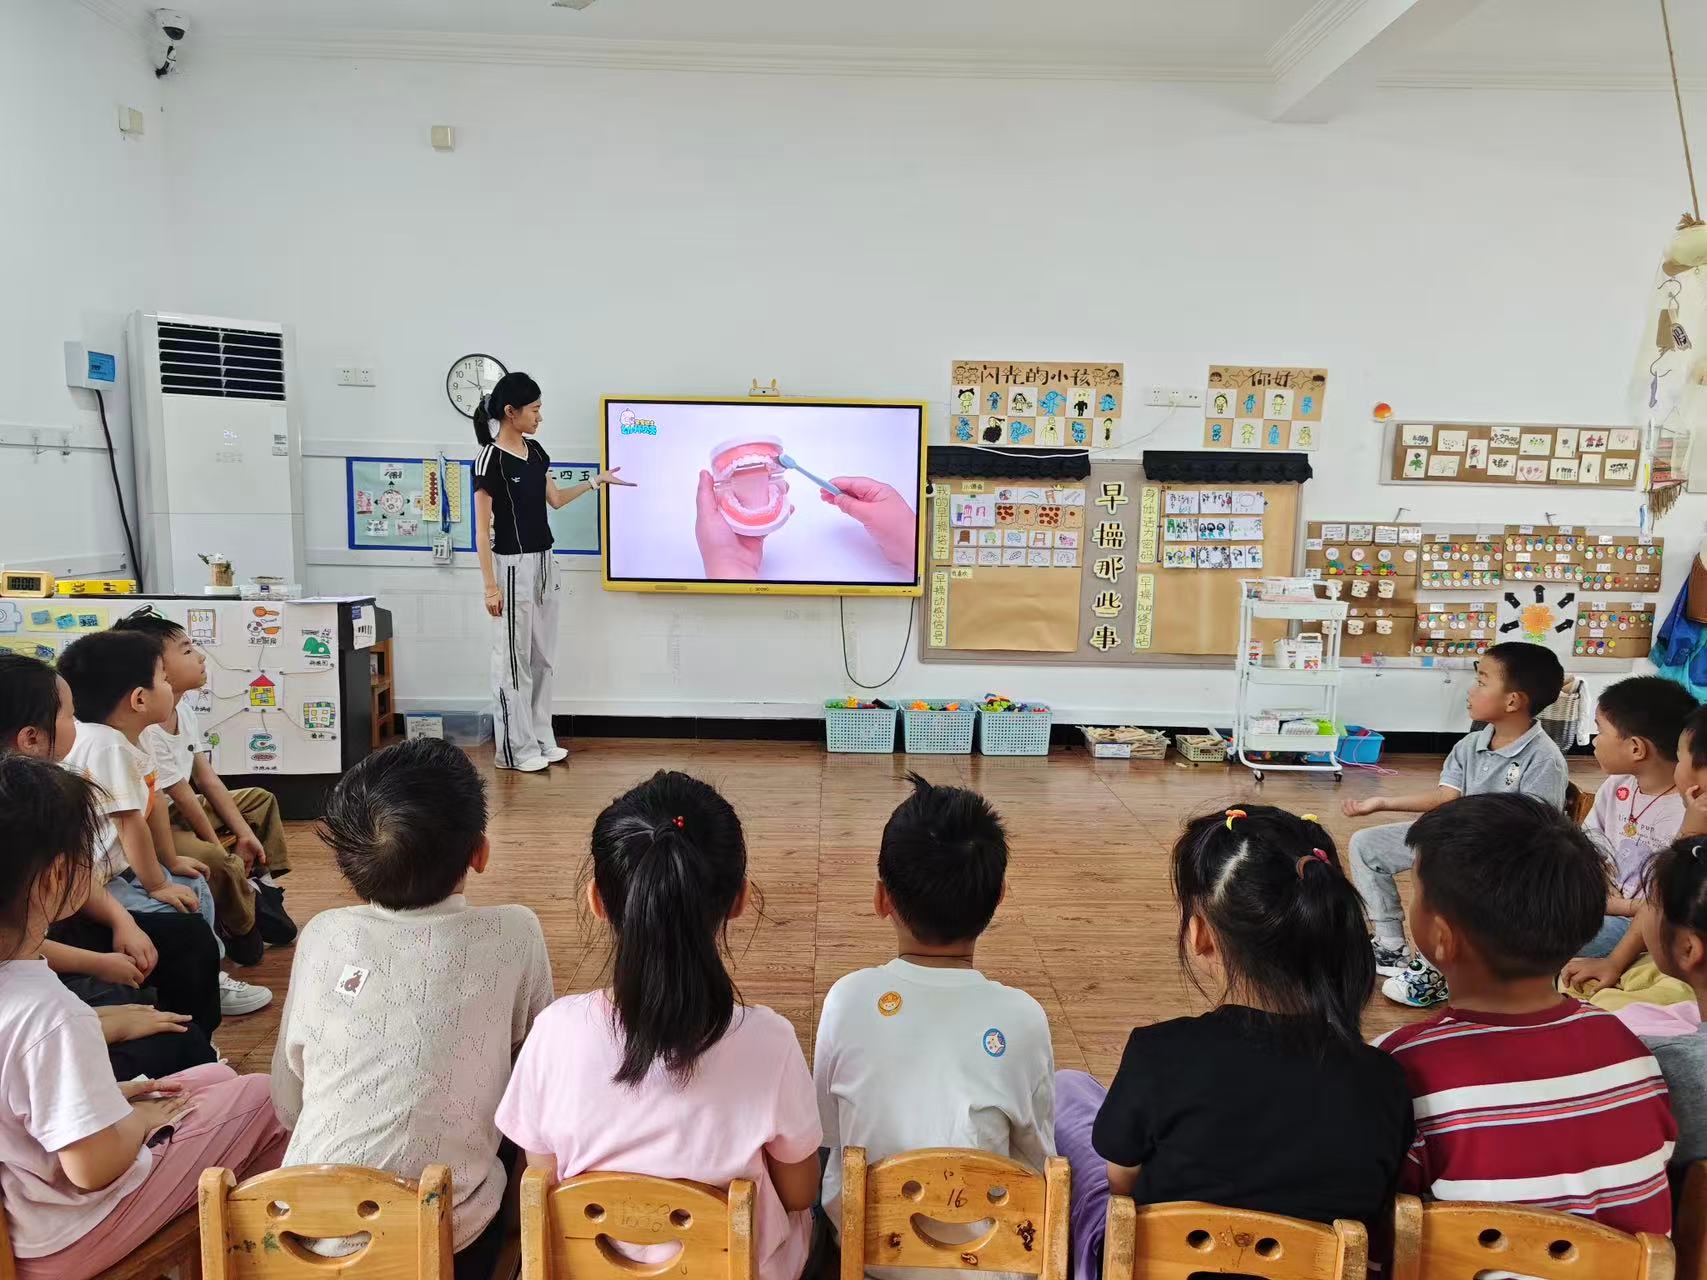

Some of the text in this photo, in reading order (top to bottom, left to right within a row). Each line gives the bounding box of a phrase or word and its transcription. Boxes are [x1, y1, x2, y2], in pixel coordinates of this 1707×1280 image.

[464, 362, 472, 370] 11
[474, 359, 484, 368] 12
[455, 370, 465, 379] 10
[980, 364, 1091, 387] 闪光的小孩
[452, 382, 459, 391] 9
[456, 394, 463, 403] 8
[465, 404, 472, 412] 7
[560, 470, 573, 480] 四
[578, 470, 590, 482] 五
[1140, 487, 1156, 562] 身体活力密码
[1092, 483, 1126, 649] 早操那些事
[932, 572, 946, 644] 早操动感信号
[946, 1188, 968, 1209] 16
